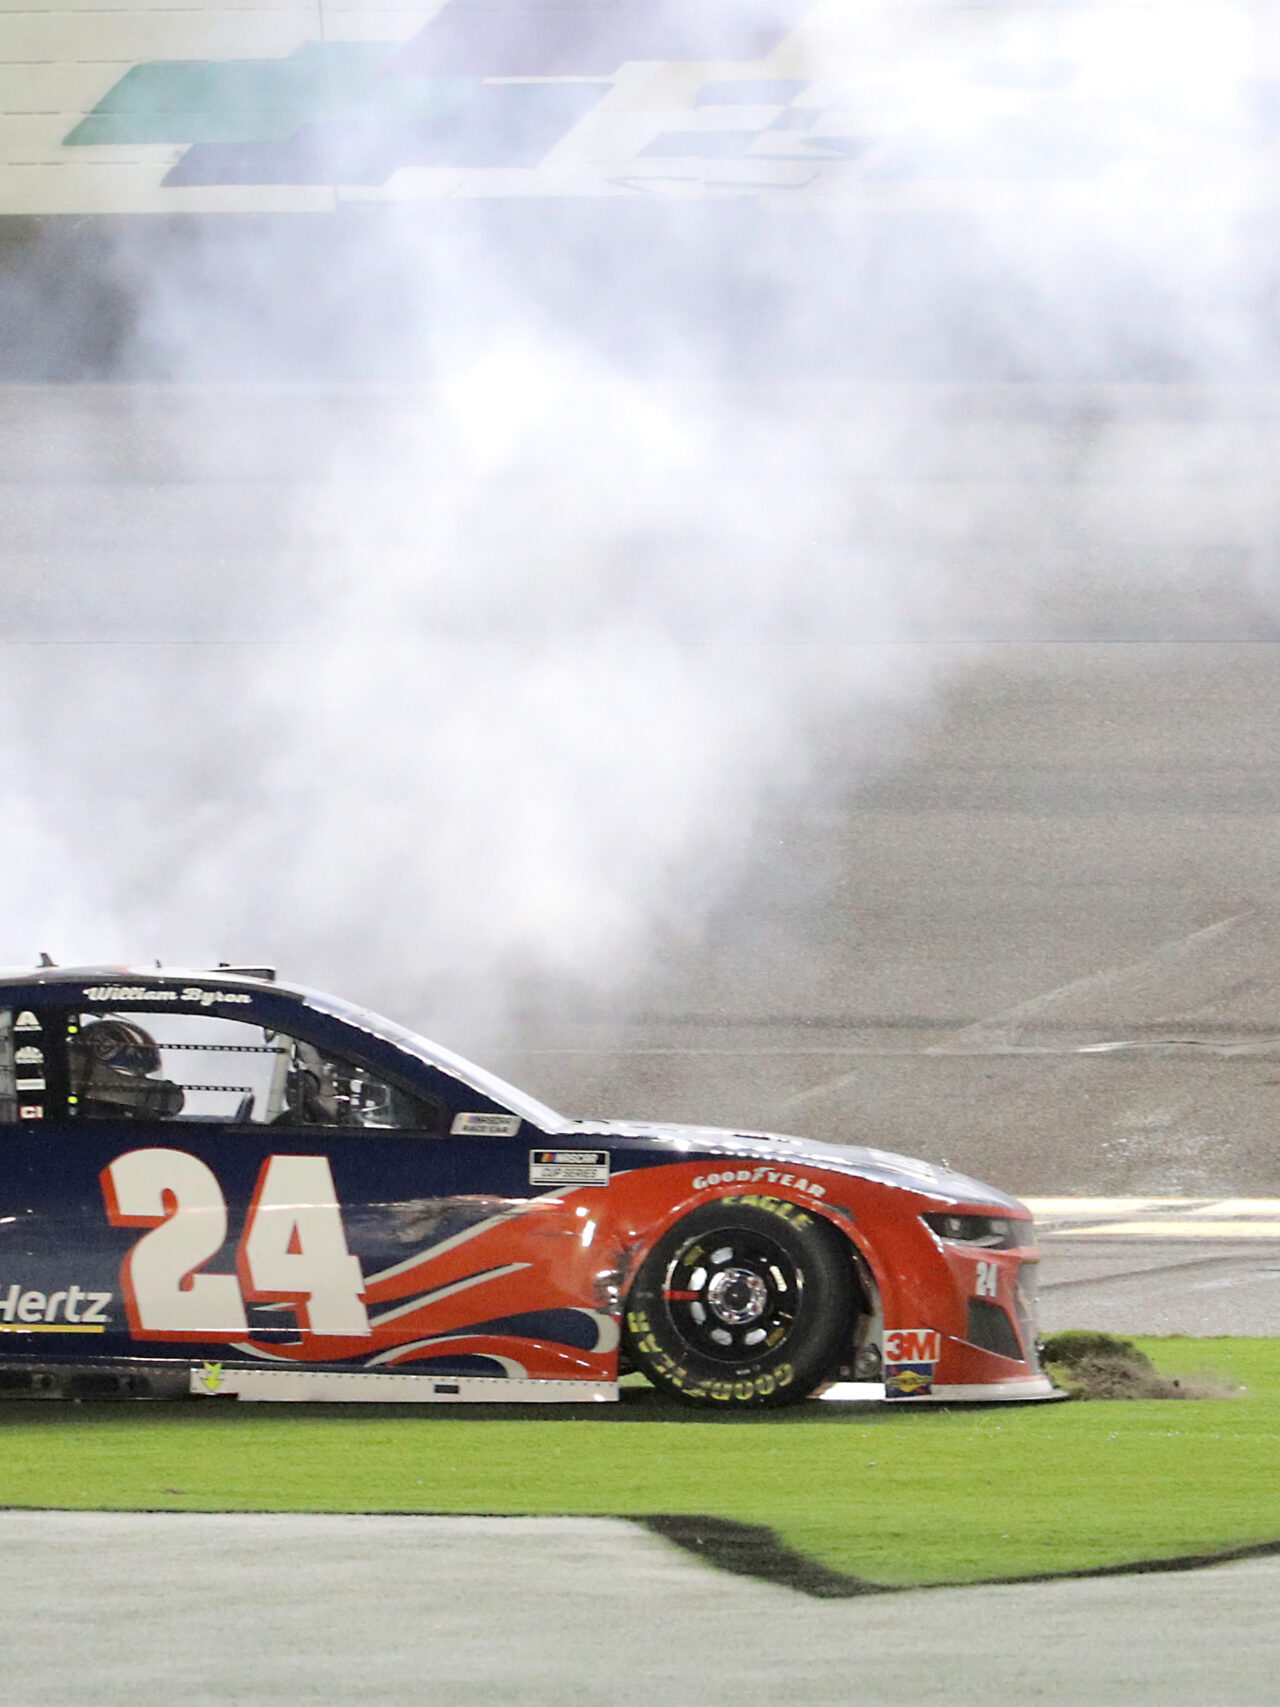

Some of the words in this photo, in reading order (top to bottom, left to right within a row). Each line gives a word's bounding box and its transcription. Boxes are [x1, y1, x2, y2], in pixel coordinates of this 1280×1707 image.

[83, 986, 178, 1001] William
[180, 987, 253, 1006] Byron
[542, 1168, 562, 1177] CUP
[563, 1168, 598, 1178] SERIES
[692, 1167, 827, 1198] GOODYEAR
[99, 1147, 372, 1342] 24
[975, 1262, 998, 1297] 24
[887, 1332, 937, 1362] 3M
